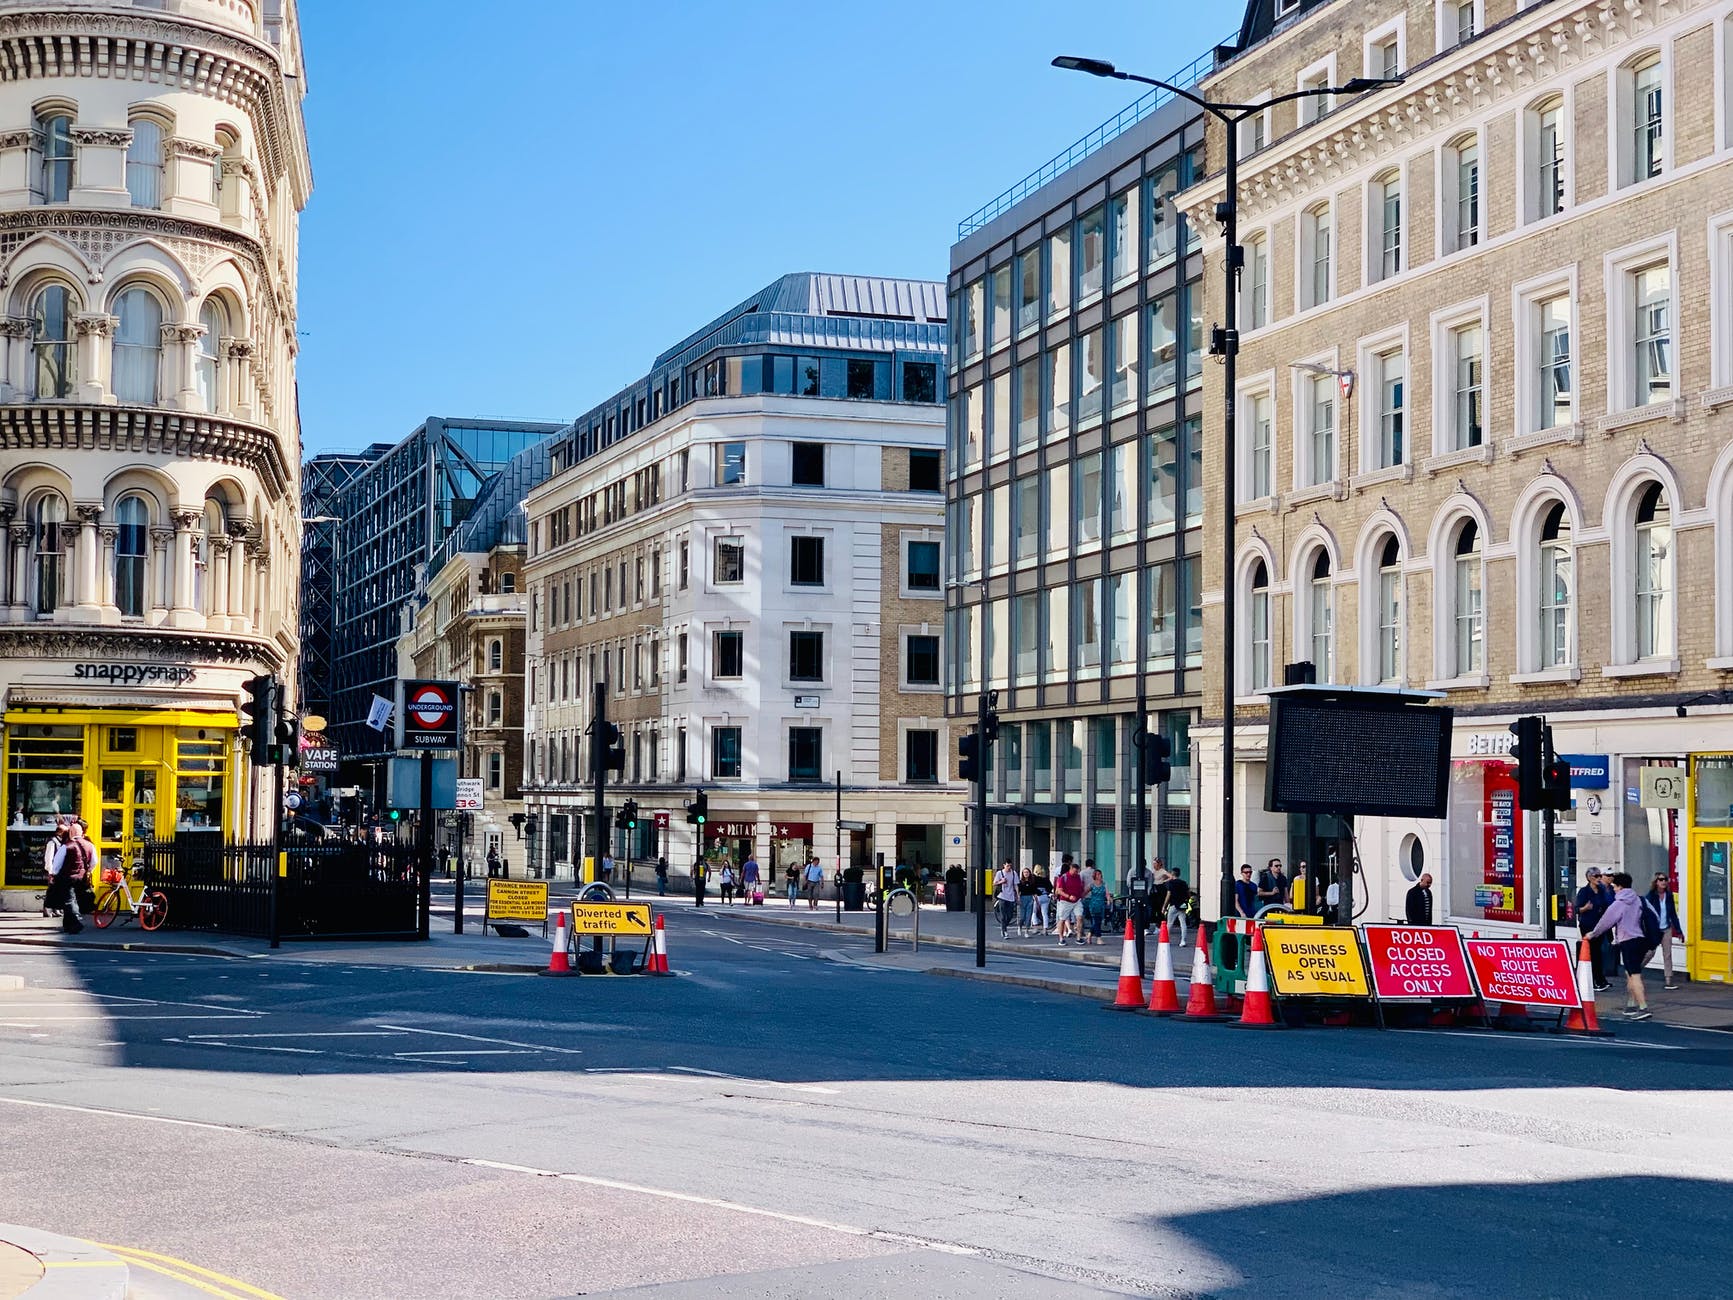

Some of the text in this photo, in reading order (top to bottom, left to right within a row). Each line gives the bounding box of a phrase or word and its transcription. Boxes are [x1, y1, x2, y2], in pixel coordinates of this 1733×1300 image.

[74, 663, 197, 686] snappysnaps
[415, 735, 447, 743] SUBWAY
[1468, 733, 1519, 754] BETFR
[305, 750, 337, 760] VAPE
[305, 761, 337, 769] STATION
[1569, 767, 1604, 776] ETFRED
[727, 824, 743, 836] PRET
[745, 825, 750, 836] A
[576, 908, 621, 918] Diverted
[583, 920, 617, 929] traffic
[1391, 930, 1434, 945] ROAD
[1281, 943, 1347, 956] BUSINESS
[1386, 947, 1446, 961] CLOSED
[1477, 945, 1557, 959] NO THROUGH
[1299, 957, 1336, 968] OPEN
[1501, 960, 1540, 972] ROUTE
[1287, 970, 1355, 982] AS USUAL
[1390, 964, 1452, 977] ACCESS
[1493, 971, 1555, 986] RESIDENTS
[1403, 979, 1443, 993] ONLY
[1488, 983, 1567, 1000] ACCESS ONLY
